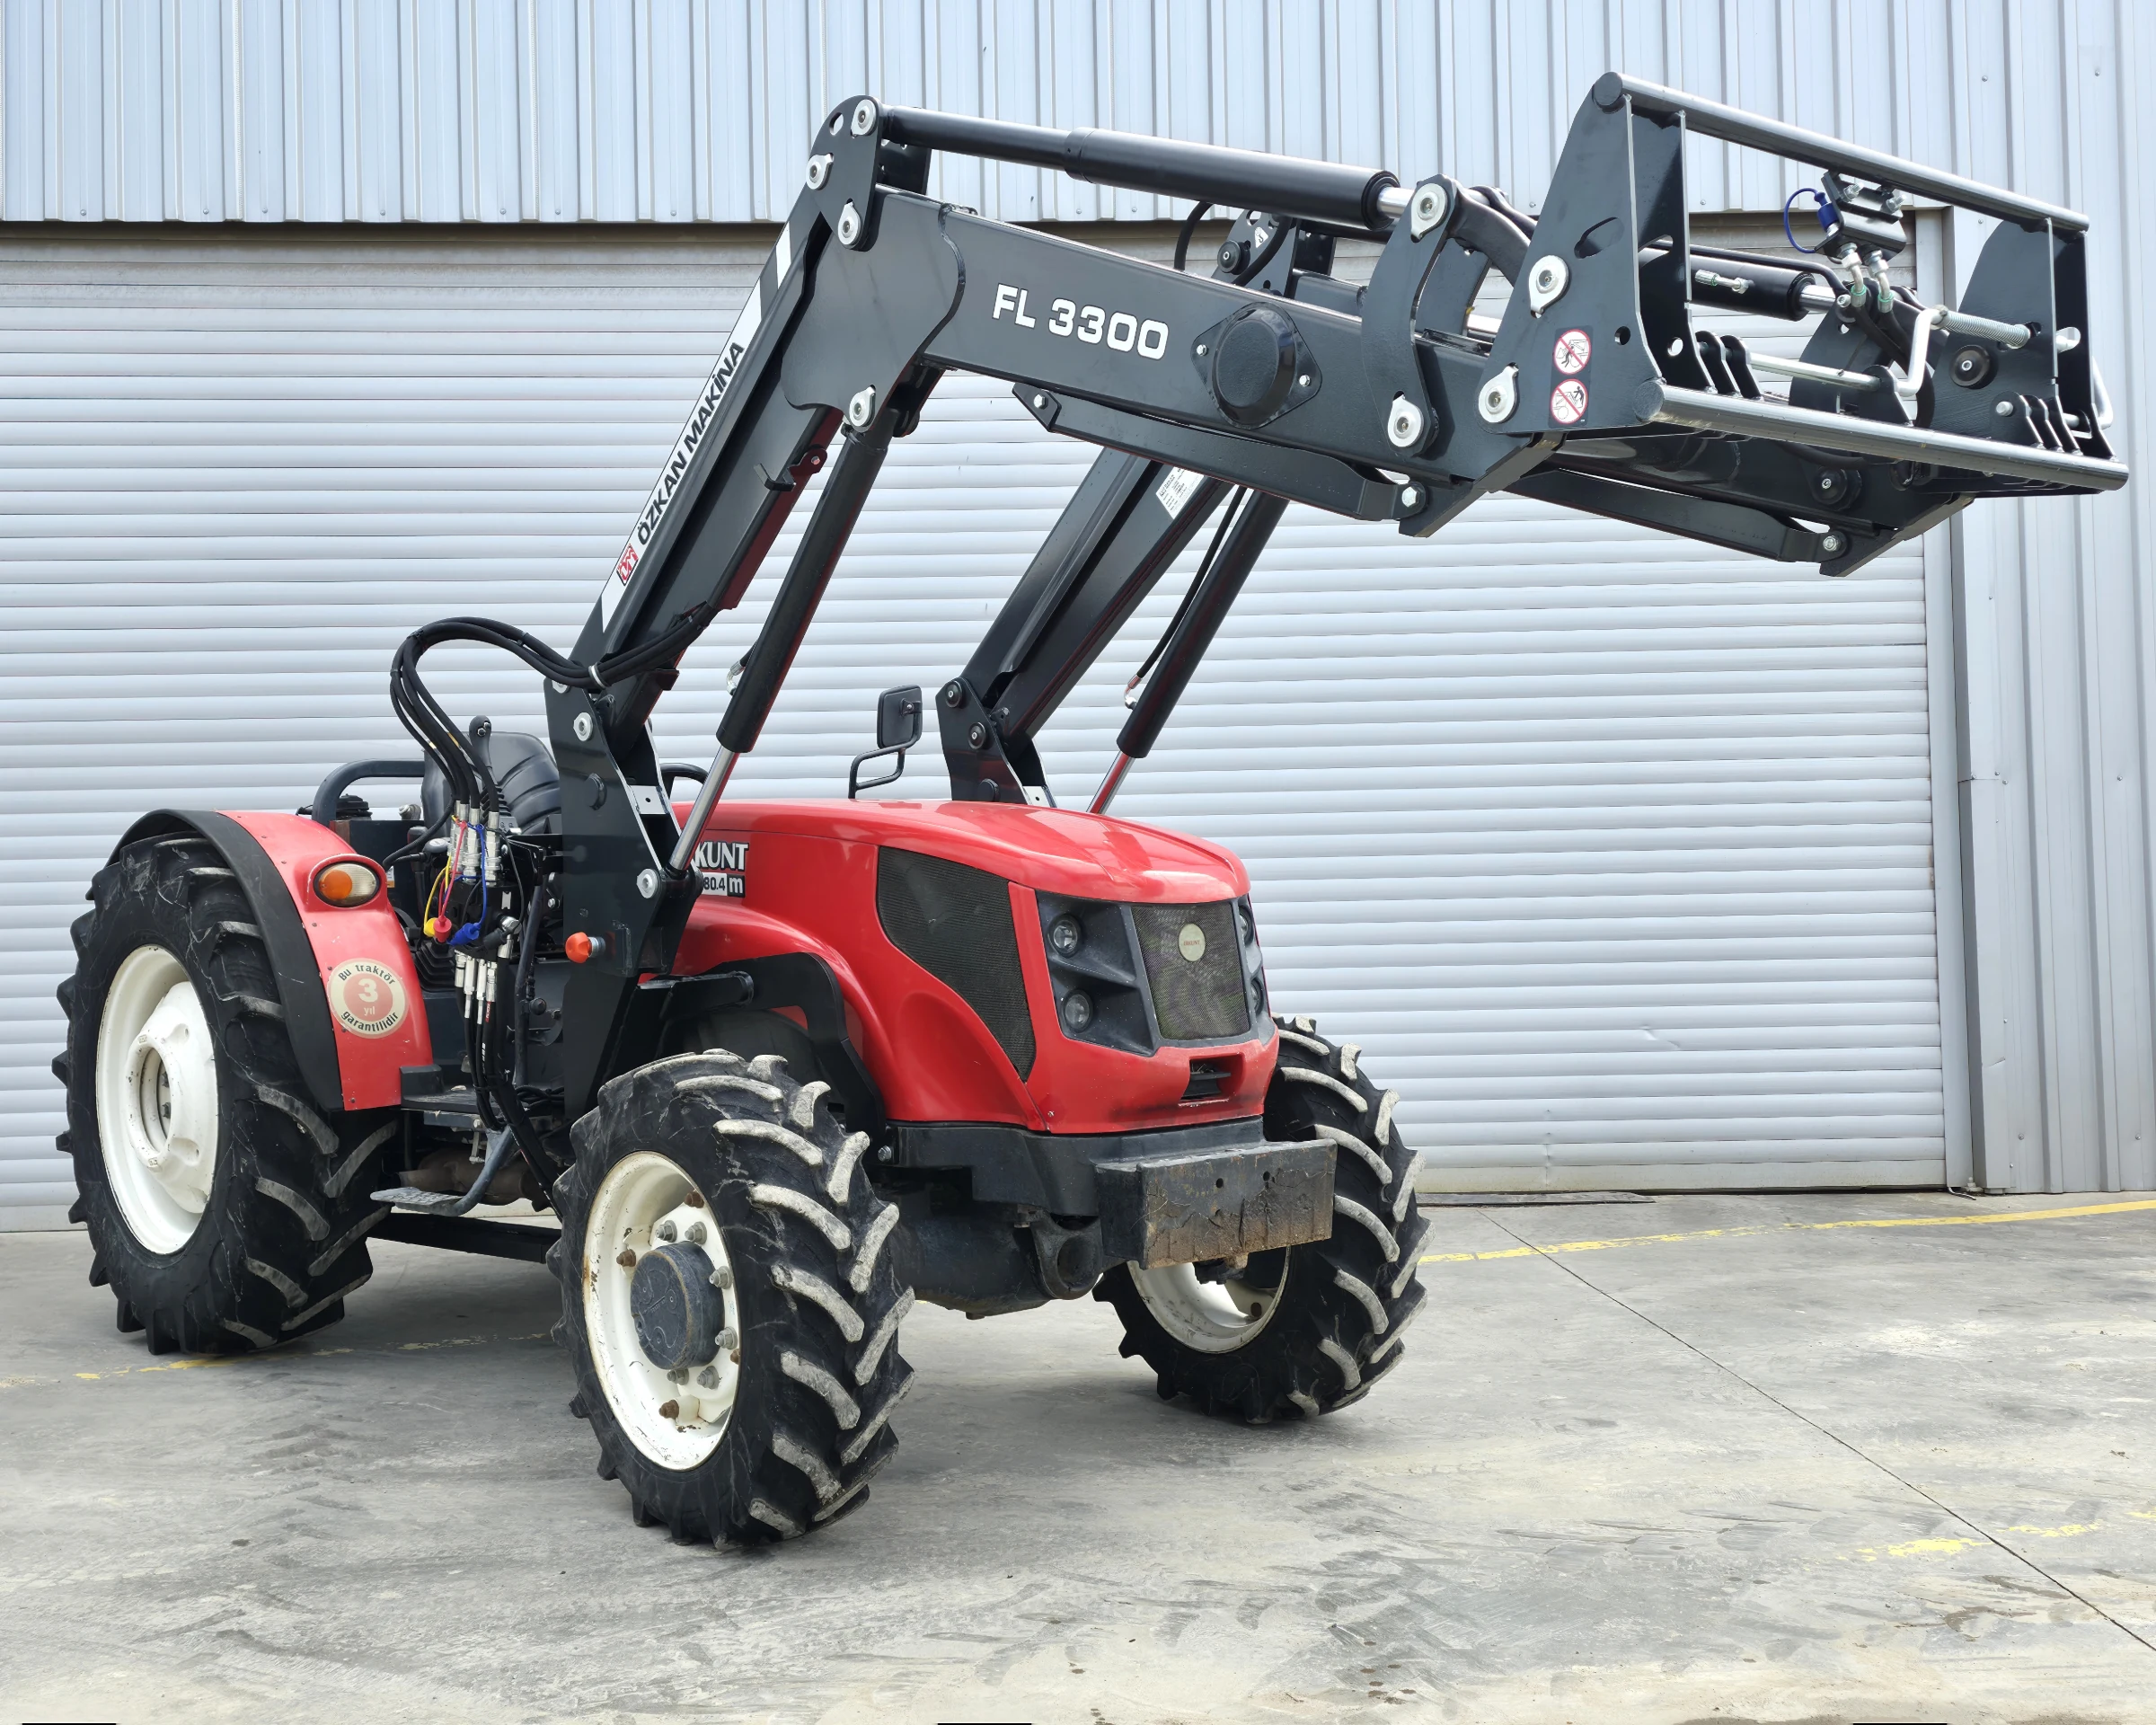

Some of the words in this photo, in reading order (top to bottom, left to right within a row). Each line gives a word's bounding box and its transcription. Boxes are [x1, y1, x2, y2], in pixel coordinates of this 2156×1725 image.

[992, 283, 1036, 329] FL
[1048, 297, 1169, 361] 3300
[637, 450, 687, 545] ÖZKAN
[684, 341, 745, 453] MAKİNA
[690, 840, 749, 871] KUNT
[729, 877, 743, 894] m
[338, 969, 351, 981] Bu
[355, 964, 395, 985] traktör
[358, 978, 378, 1003] 3
[341, 1011, 398, 1032] garantilidir
